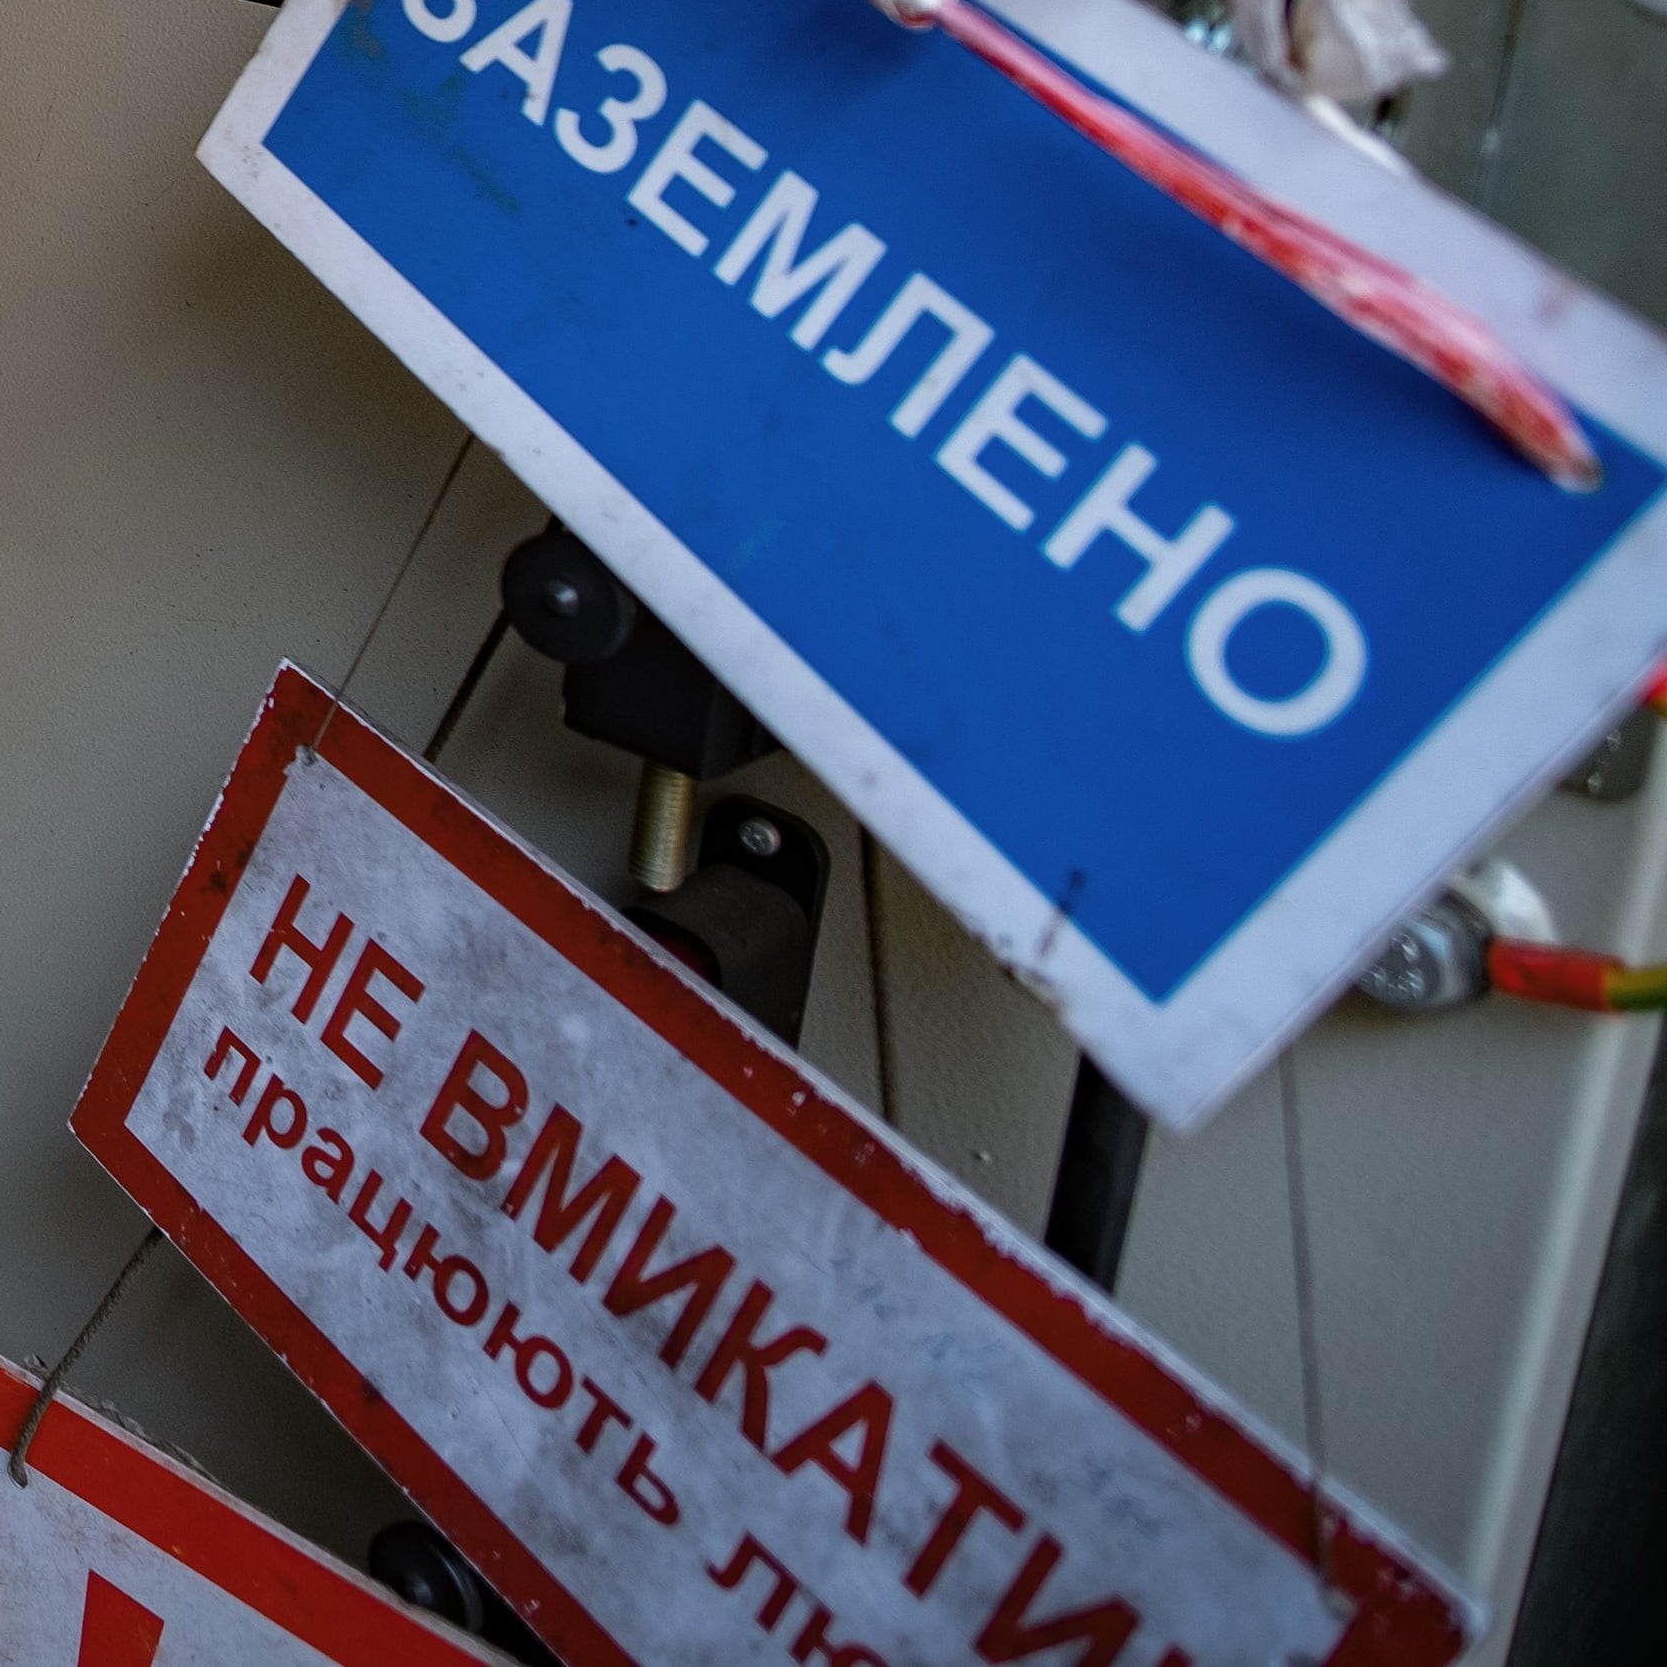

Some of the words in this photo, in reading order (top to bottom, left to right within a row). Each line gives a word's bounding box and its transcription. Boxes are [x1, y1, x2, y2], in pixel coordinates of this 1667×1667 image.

[204, 1026, 682, 1526] працюють
[250, 875, 424, 1090] НЕ
[420, 1030, 1190, 1667] ВМИКАТИ
